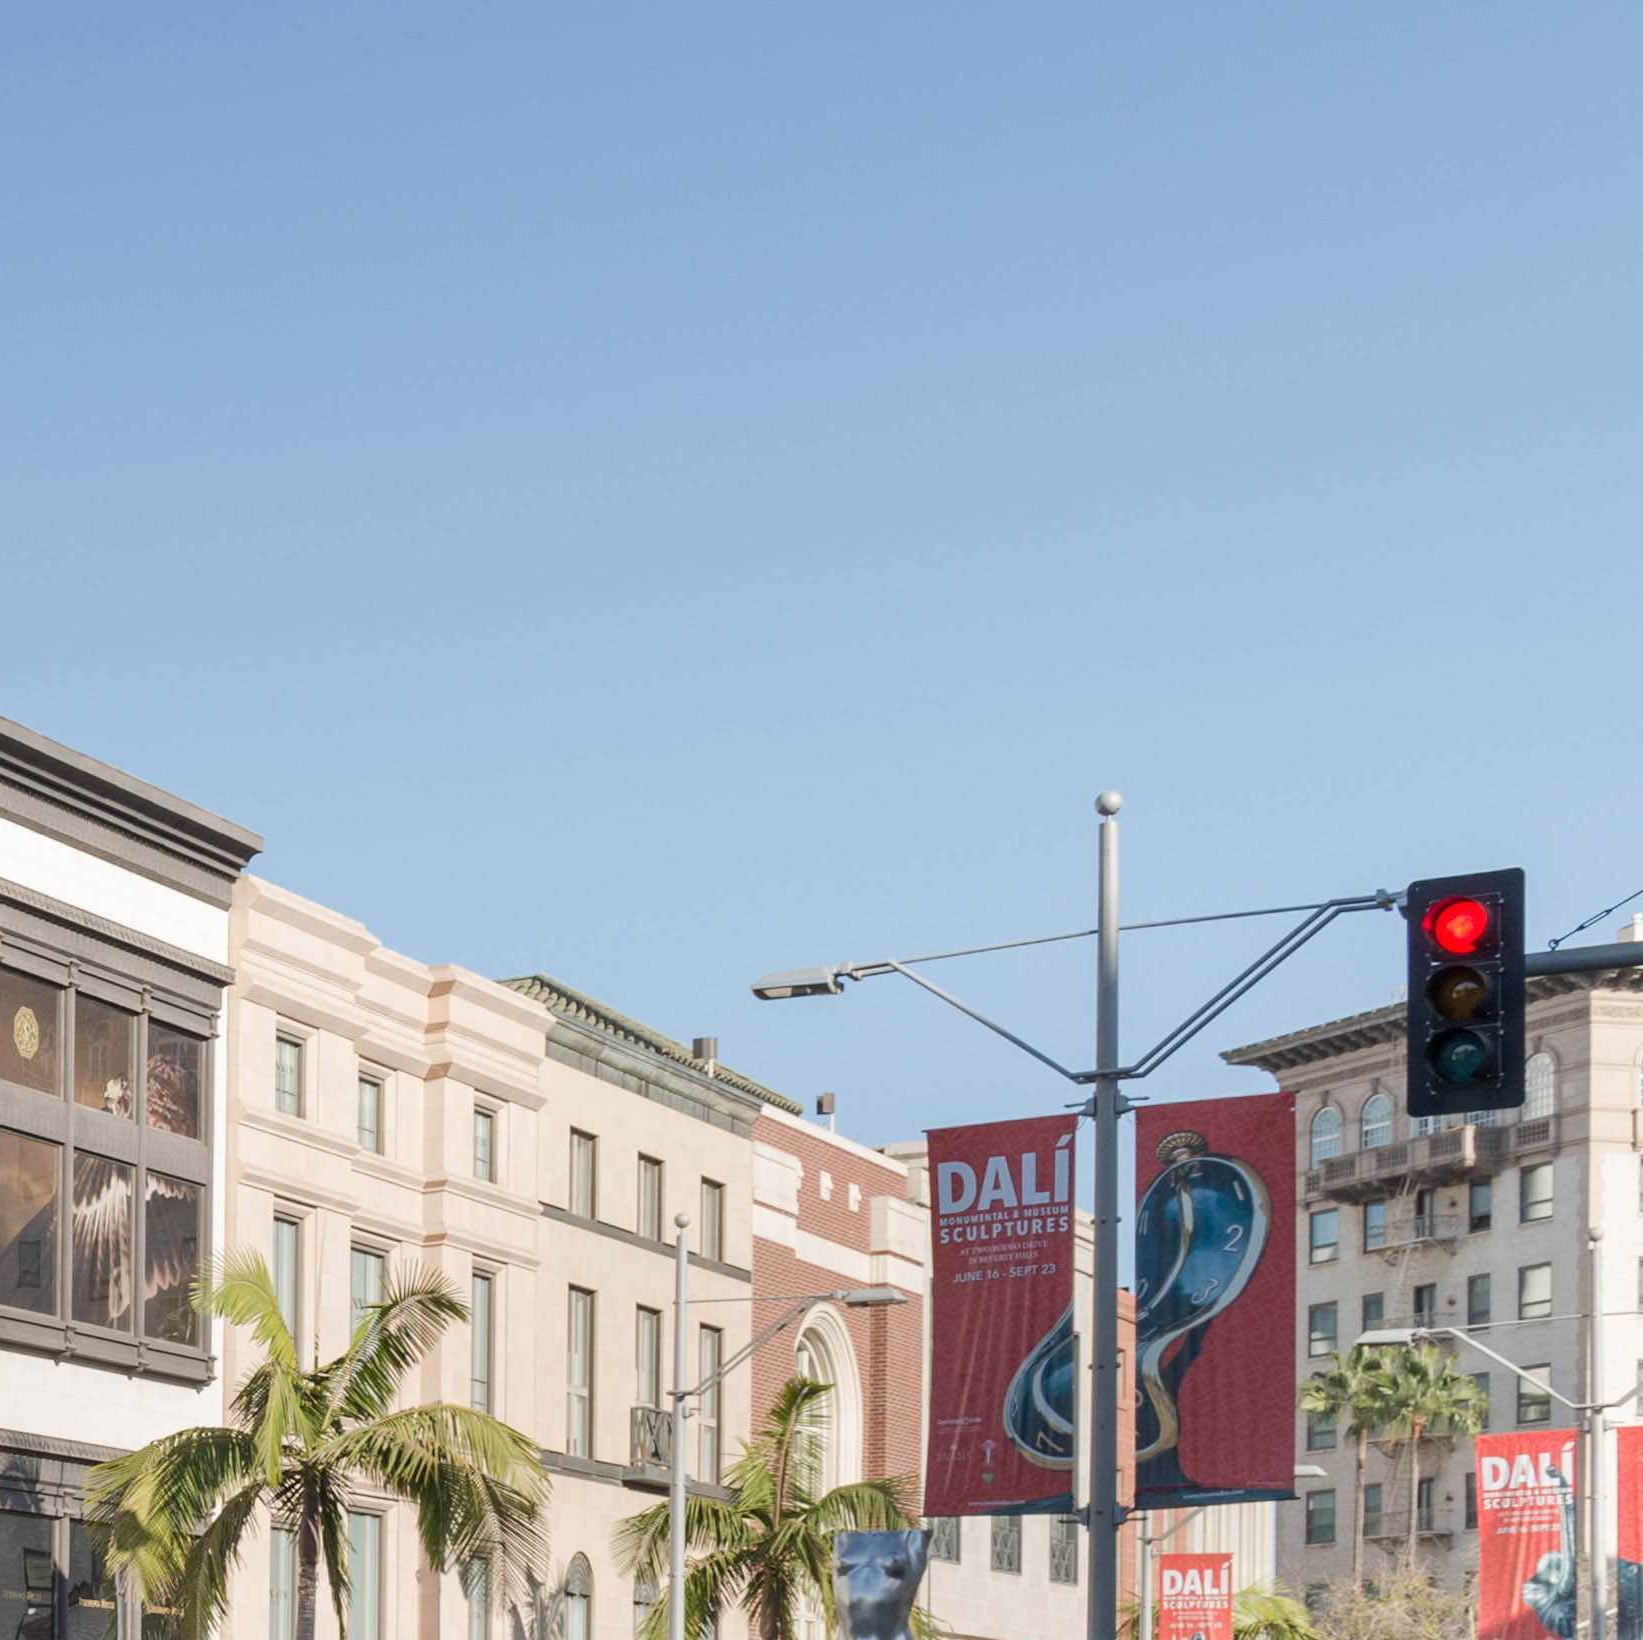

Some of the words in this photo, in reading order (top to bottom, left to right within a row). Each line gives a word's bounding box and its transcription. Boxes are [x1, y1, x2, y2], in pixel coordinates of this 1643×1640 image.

[937, 1133, 1074, 1215] DALÍ
[939, 1211, 1009, 1226] MONUMENTAL
[1024, 1205, 1069, 1217] MUSEUM
[939, 1216, 1069, 1245] SCULPTURES
[1223, 1224, 1244, 1252] 2
[954, 1269, 984, 1283] JUNE
[987, 1268, 1000, 1279] 16
[1010, 1264, 1038, 1278] SEPT
[1042, 1263, 1056, 1275] 23
[1481, 1441, 1576, 1491] DALÍ
[1483, 1494, 1574, 1510] SCULPTURES
[1163, 1560, 1233, 1595] DALÍ
[1163, 1599, 1229, 1609] SCULPTURES
